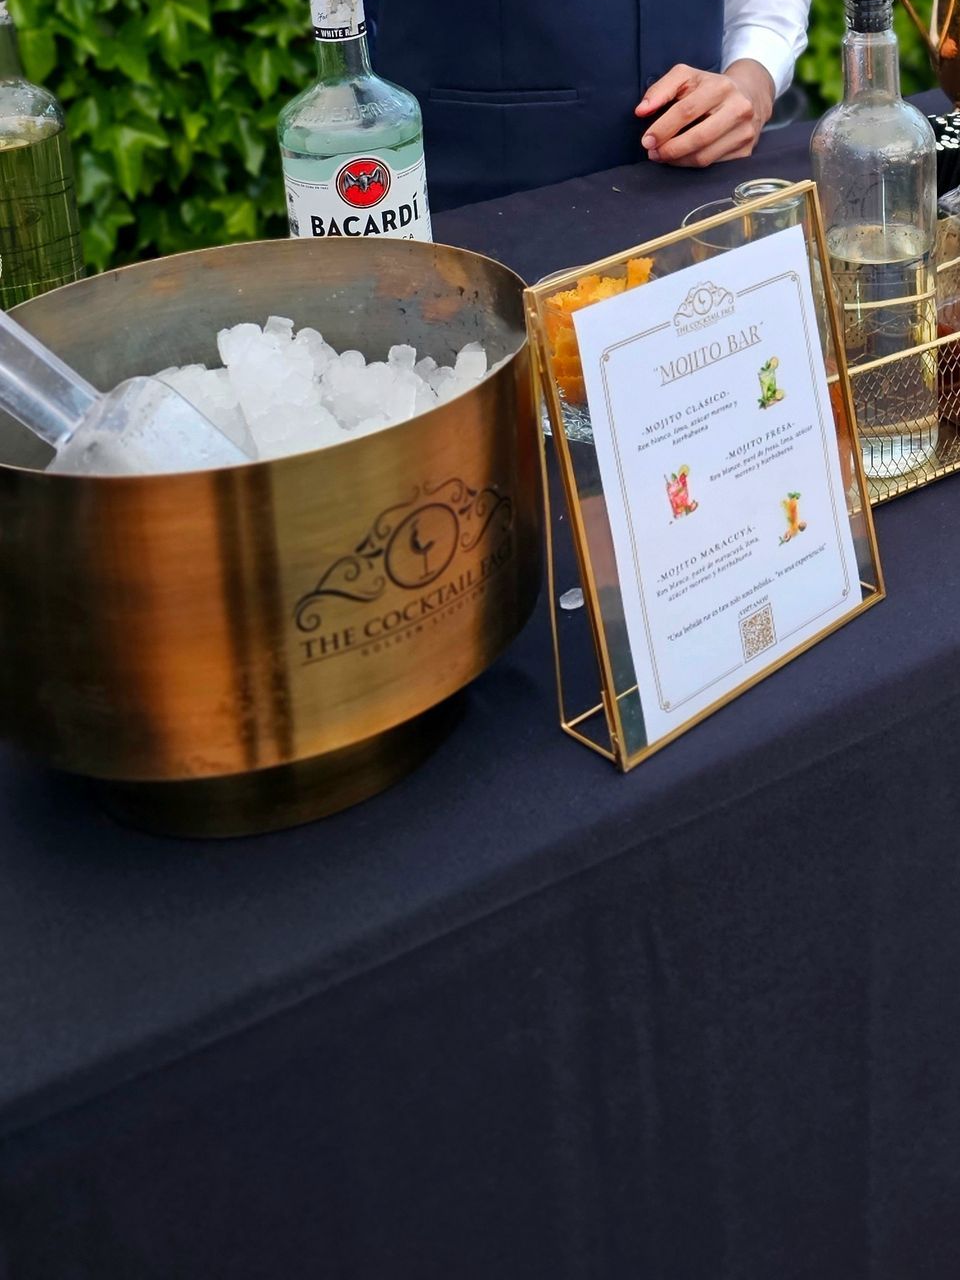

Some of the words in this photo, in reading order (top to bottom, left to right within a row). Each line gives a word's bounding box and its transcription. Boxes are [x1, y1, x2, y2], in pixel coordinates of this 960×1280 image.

[320, 28, 343, 38] WHITE
[310, 192, 418, 237] BACARDÍ
[301, 627, 355, 660] THE
[363, 570, 478, 639] COCKTAIL
